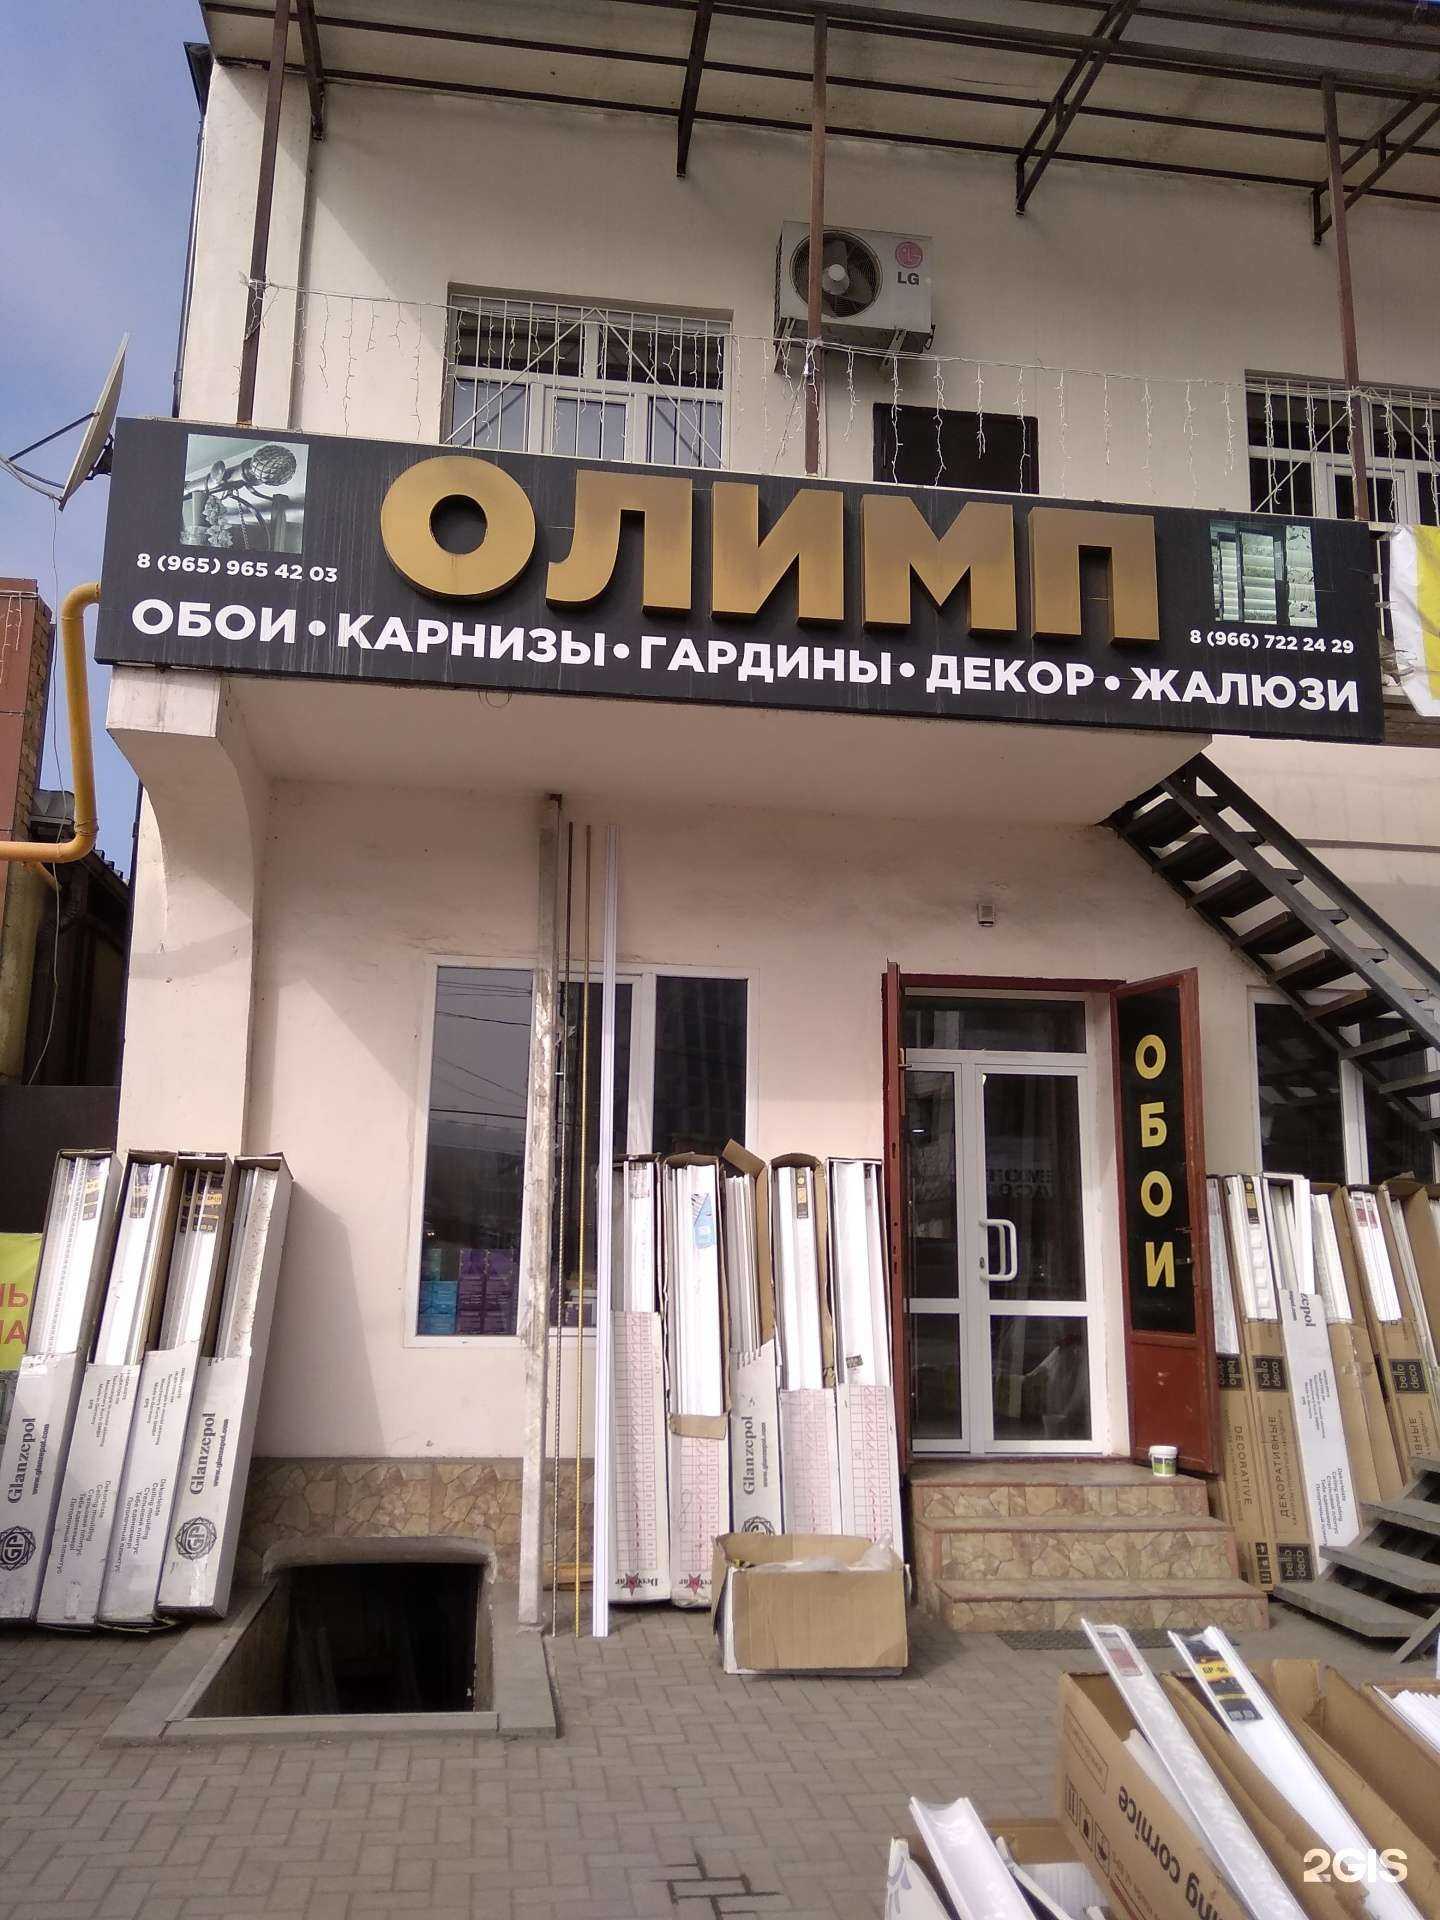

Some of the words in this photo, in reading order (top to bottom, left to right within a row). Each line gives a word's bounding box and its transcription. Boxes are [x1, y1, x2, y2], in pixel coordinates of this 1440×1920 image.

[897, 271, 920, 286] LG
[136, 553, 151, 569] 8
[157, 554, 221, 575] (965)
[226, 559, 269, 578] 965
[274, 563, 303, 580] 42
[309, 566, 338, 583] 03
[380, 455, 1160, 643] ОЛИМП
[131, 598, 297, 644] ОБОИ
[337, 612, 606, 667] КАРНИЗЫ
[640, 635, 892, 685] ГАРДИНЫ
[925, 654, 1095, 696] ДЕКОР
[1130, 666, 1359, 713] ЖАЛЮЗИ
[1189, 629, 1202, 644] 8
[1206, 630, 1259, 650] (966)
[1264, 634, 1298, 651] 722
[1302, 637, 1327, 653] 24
[1331, 638, 1354, 654] 29
[1134, 1034, 1176, 1289] ОБОИ
[7, 1417, 36, 1504] Glanzepol
[189, 1412, 216, 1495] Glanzepol
[741, 1415, 757, 1496] Glanzepol
[1233, 1425, 1253, 1505] DECORATIVE
[1267, 1416, 1291, 1518] ДЕКОРАТИВНЫЕ
[1117, 1785, 1181, 1884] cornice
